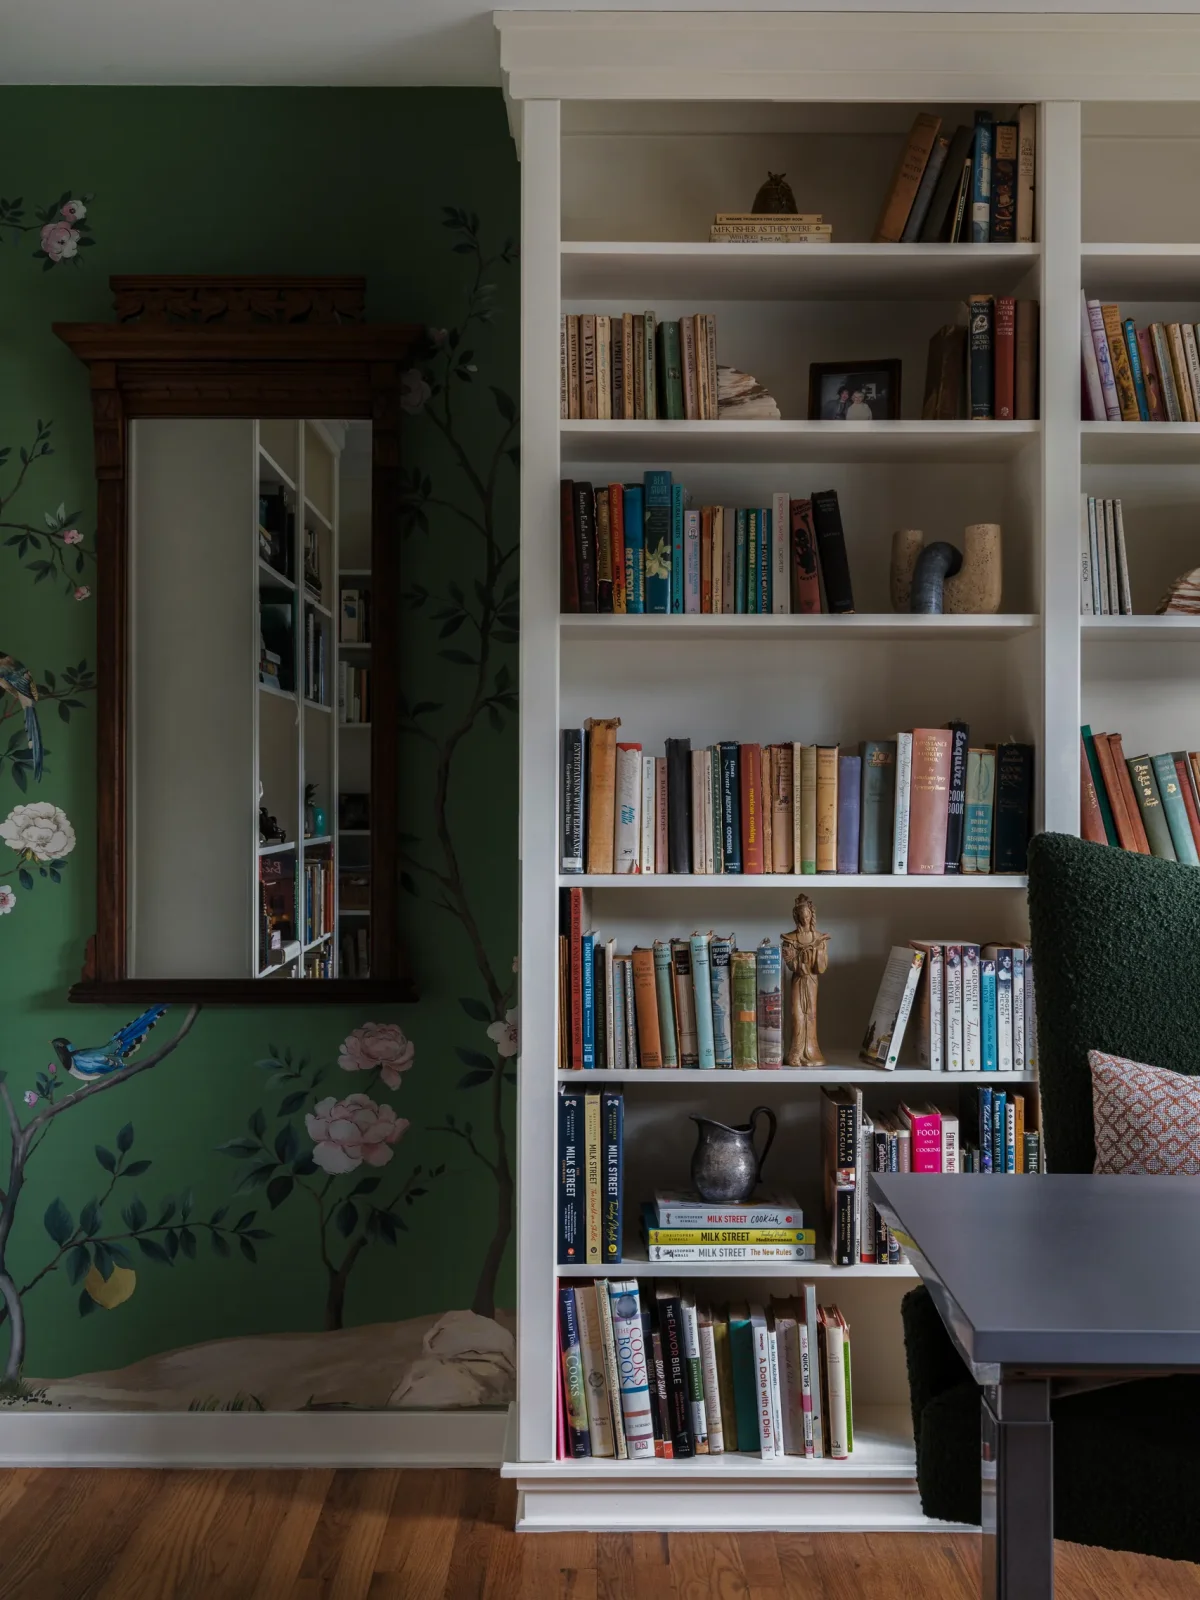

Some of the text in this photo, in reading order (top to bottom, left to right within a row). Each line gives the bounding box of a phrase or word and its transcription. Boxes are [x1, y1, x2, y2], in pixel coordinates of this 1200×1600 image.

[585, 335, 594, 384] VENETIA
[580, 515, 588, 532] Ends
[626, 548, 634, 566] REX
[573, 743, 581, 796] ENTERTAINING
[952, 730, 967, 787] Esquire
[573, 797, 581, 817] WITH
[621, 804, 629, 826] Child
[628, 807, 636, 824] Julia
[749, 816, 757, 844] cooking
[573, 946, 581, 961] AND
[573, 963, 581, 994] SMOOTH
[584, 942, 592, 1009] DANDIE DINMONT TERRIER
[966, 1015, 979, 1053] Frederica
[917, 1129, 940, 1137] FOOD
[946, 1132, 956, 1150] EATING
[566, 1146, 576, 1166] MILK
[589, 1144, 598, 1160] MILK
[846, 1150, 853, 1162] TO
[1029, 1152, 1038, 1169] THE
[589, 1161, 598, 1185] STREET
[608, 1144, 618, 1196] MILK STREET
[566, 1168, 576, 1198] STREET
[707, 1215, 748, 1223] MILK STREET
[700, 1231, 750, 1242] MILK STREET
[698, 1248, 792, 1258] MILK STREET The New Rules
[668, 1319, 679, 1356] FLAVOR
[703, 1330, 712, 1359] INSTANT
[618, 1337, 633, 1386] BOOK
[630, 1327, 647, 1386] COOK'S
[566, 1355, 580, 1397] COOKS
[655, 1359, 667, 1400] SOUP SWAP
[671, 1356, 682, 1384] BIBLE
[692, 1363, 701, 1399] MINIMALIST
[759, 1366, 768, 1388] Date
[761, 1390, 769, 1408] with
[762, 1418, 771, 1439] Dish
